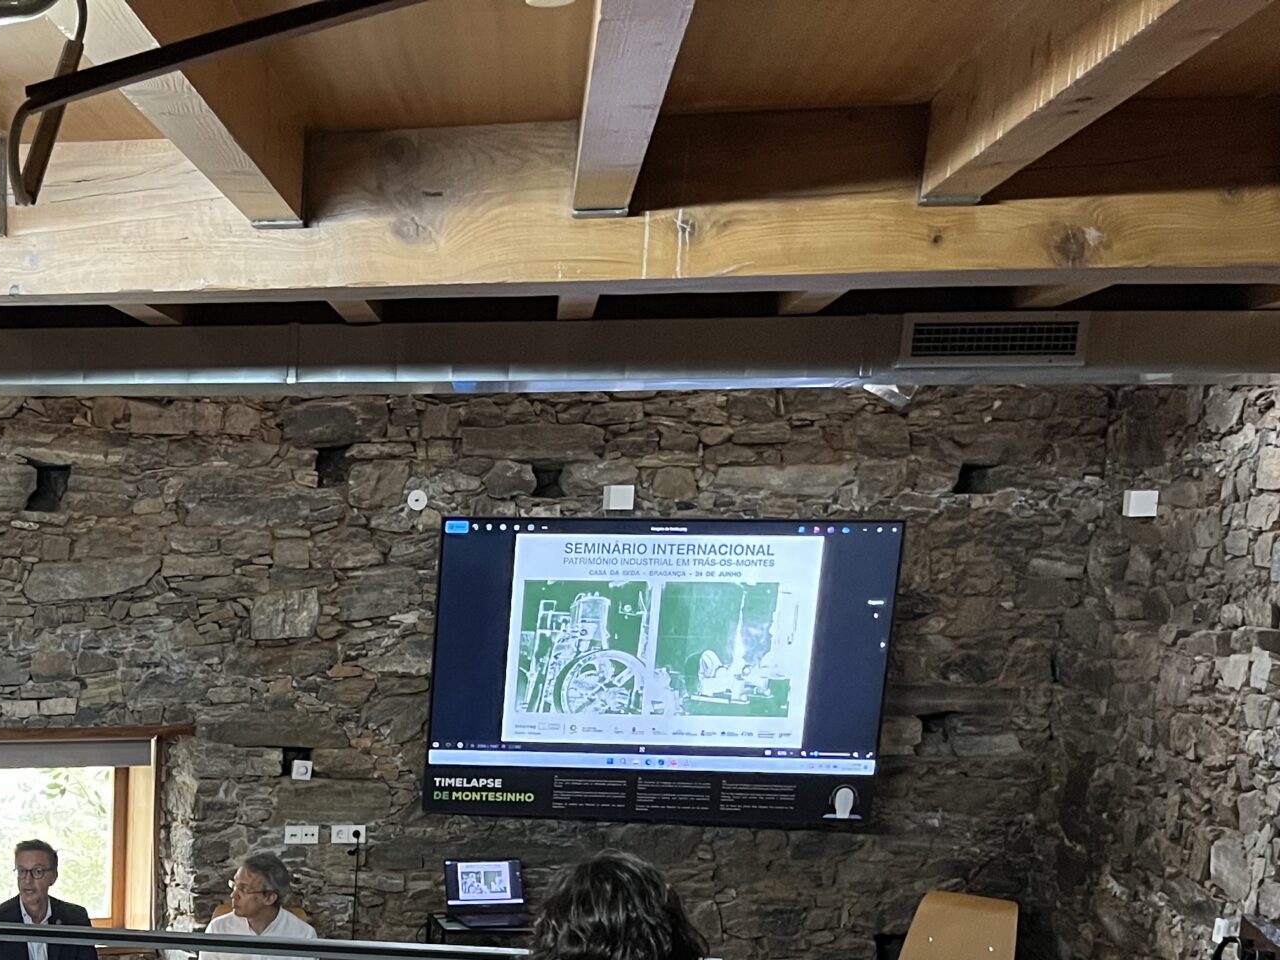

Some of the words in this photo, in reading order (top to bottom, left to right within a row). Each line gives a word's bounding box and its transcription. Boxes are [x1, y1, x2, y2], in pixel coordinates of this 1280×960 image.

[564, 540, 647, 555] SEMINÁRIO
[652, 543, 775, 556] INTERNACIONAL
[563, 556, 618, 566] PATRIMÓNIO
[620, 558, 673, 566] INDUSTRIAL
[676, 559, 690, 567] EM
[693, 557, 775, 567] TRÁS-OS-MONTES
[434, 777, 502, 788] TIMELAPSE
[433, 791, 449, 800] DE
[452, 792, 535, 802] MONTESINHO
